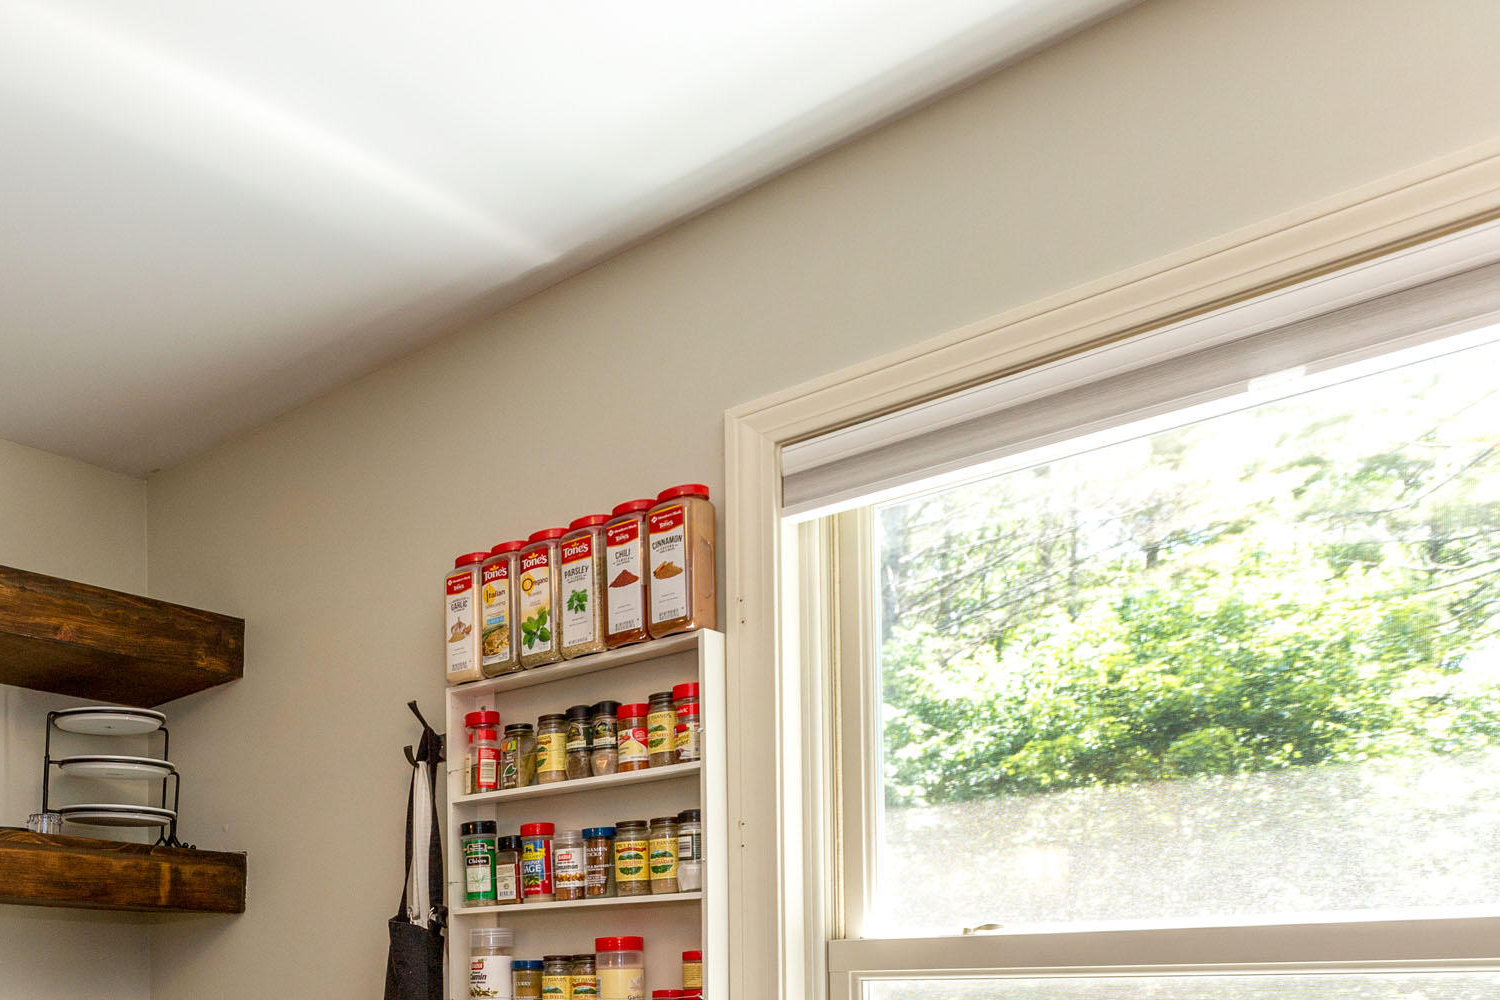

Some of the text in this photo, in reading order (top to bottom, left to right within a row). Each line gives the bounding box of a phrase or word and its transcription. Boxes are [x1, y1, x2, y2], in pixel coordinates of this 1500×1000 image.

[652, 534, 683, 550] CINNAMON
[563, 542, 589, 558] Tone's
[615, 548, 630, 560] CHILI
[522, 554, 548, 570] Tone's
[484, 566, 508, 582] Tone's
[564, 565, 590, 579] PARSLEY
[522, 577, 549, 592] Oregano
[486, 589, 506, 603] Italian
[451, 599, 468, 611] GARLIC
